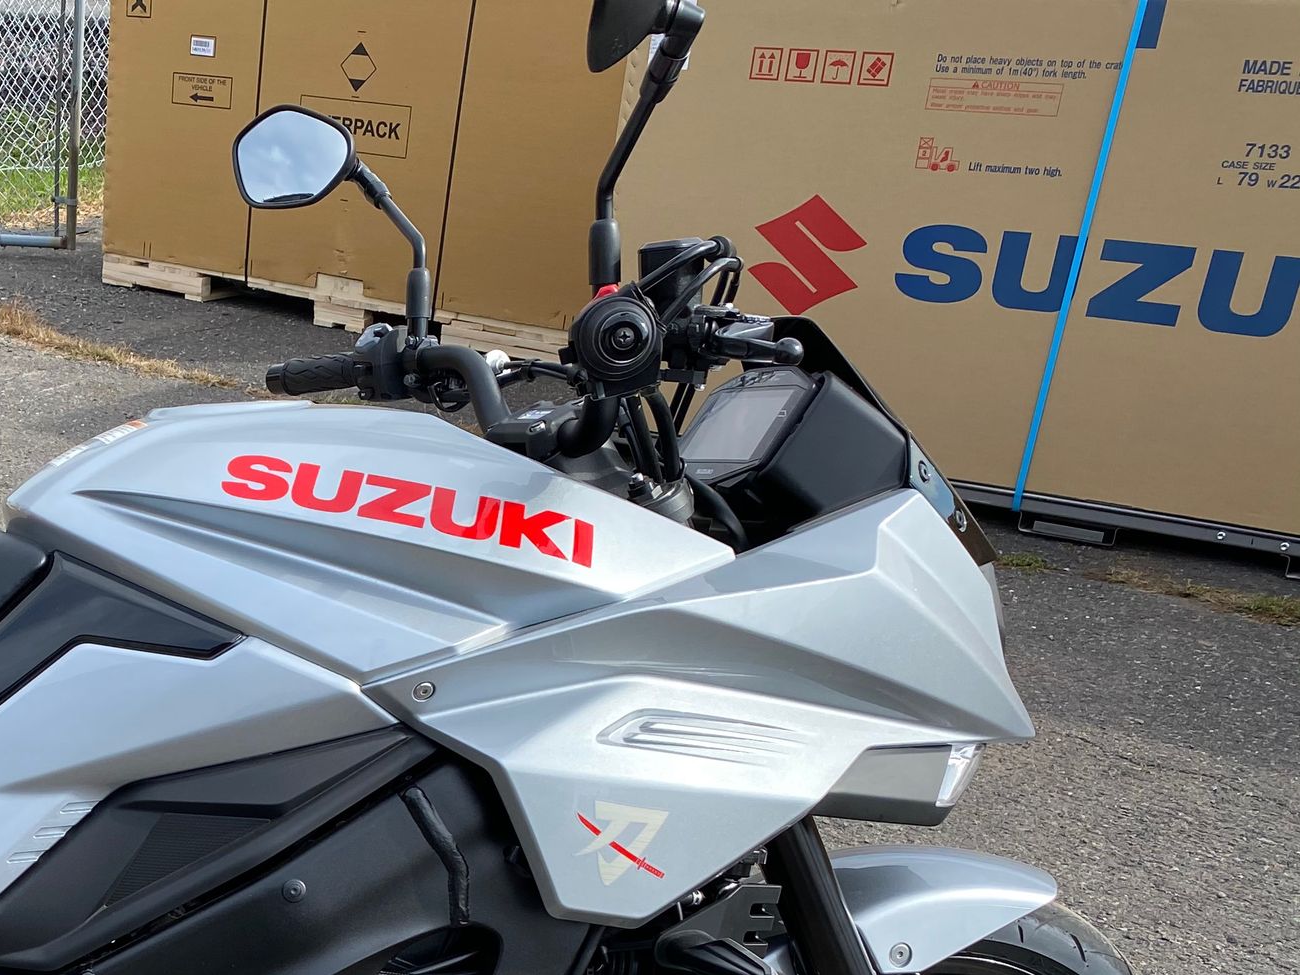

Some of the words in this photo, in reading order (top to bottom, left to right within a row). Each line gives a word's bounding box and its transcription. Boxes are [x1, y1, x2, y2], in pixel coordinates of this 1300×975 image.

[937, 54, 947, 63] Do
[950, 55, 963, 64] not
[965, 55, 986, 65] place
[989, 56, 1012, 67] heavy
[1015, 57, 1043, 68] objects
[1060, 59, 1073, 69] top
[1076, 59, 1086, 69] of
[1089, 60, 1102, 70] the
[1105, 61, 1124, 70] crat
[1242, 59, 1293, 76] MADE
[935, 64, 949, 73] Use
[961, 65, 992, 75] minimum
[996, 66, 1004, 75] of
[1042, 68, 1057, 77] fork
[1061, 69, 1087, 79] length.
[981, 80, 1020, 90] CAUTION
[1245, 143, 1292, 159] 7133
[968, 161, 982, 172] Lift
[985, 163, 1022, 175] maximum
[1025, 165, 1040, 176] two
[1043, 166, 1063, 178] high.
[1221, 160, 1249, 170] CASE
[1252, 161, 1276, 171] SIZE
[1238, 172, 1259, 187] 79
[221, 455, 594, 568] SUZUKI
